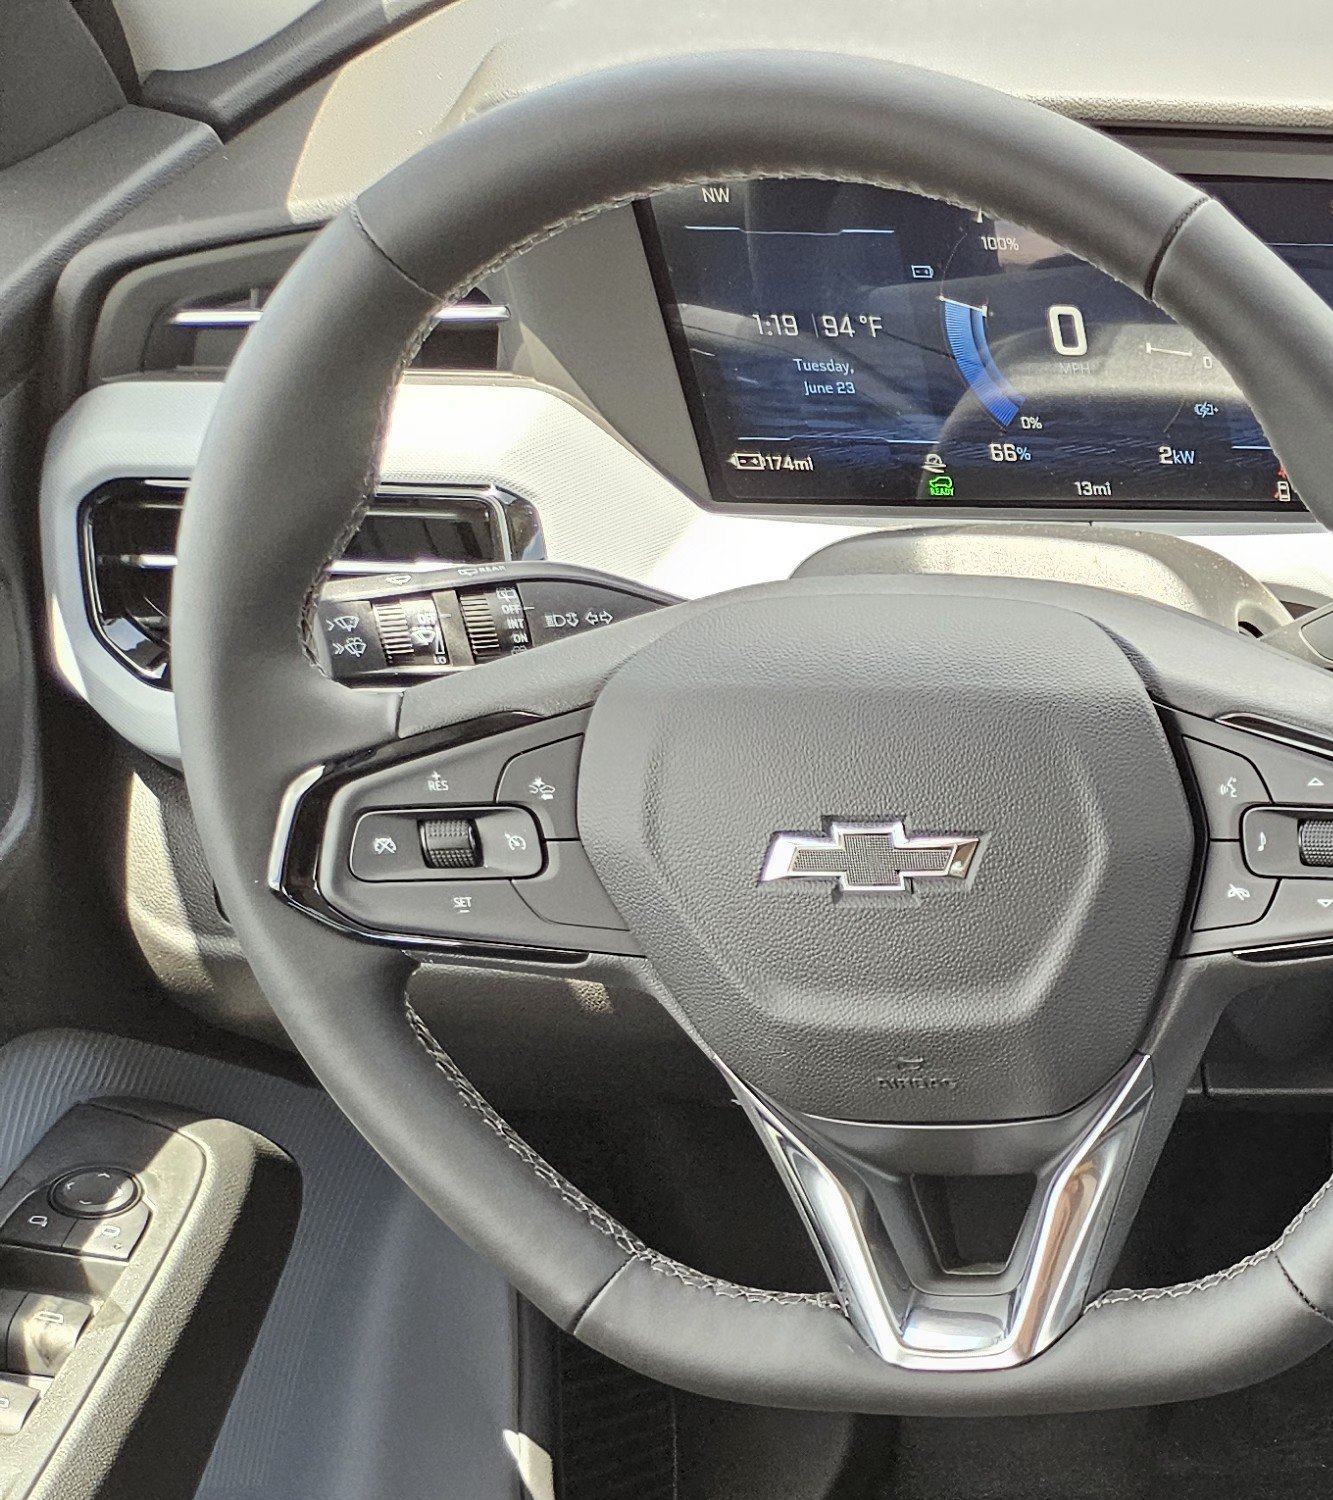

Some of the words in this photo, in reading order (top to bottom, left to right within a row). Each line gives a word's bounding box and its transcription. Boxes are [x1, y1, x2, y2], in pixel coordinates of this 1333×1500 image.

[702, 187, 730, 203] NW
[981, 236, 1019, 251] 100%
[752, 314, 798, 336] 1:19
[1049, 305, 1088, 356] 0
[793, 358, 855, 376] Tuesday,
[1059, 363, 1090, 374] MPH
[804, 381, 833, 396] June
[836, 382, 855, 394] 23
[1020, 416, 1043, 430] 0%
[988, 443, 1031, 462] 66%
[766, 456, 814, 471] 174mi
[1074, 481, 1112, 496] 13mi
[478, 565, 507, 573] REAR
[501, 605, 523, 615] OFF
[417, 613, 436, 624] OFF
[507, 619, 525, 629] INT
[513, 633, 528, 644] ON
[428, 780, 449, 791] RES
[454, 897, 472, 908] SET
